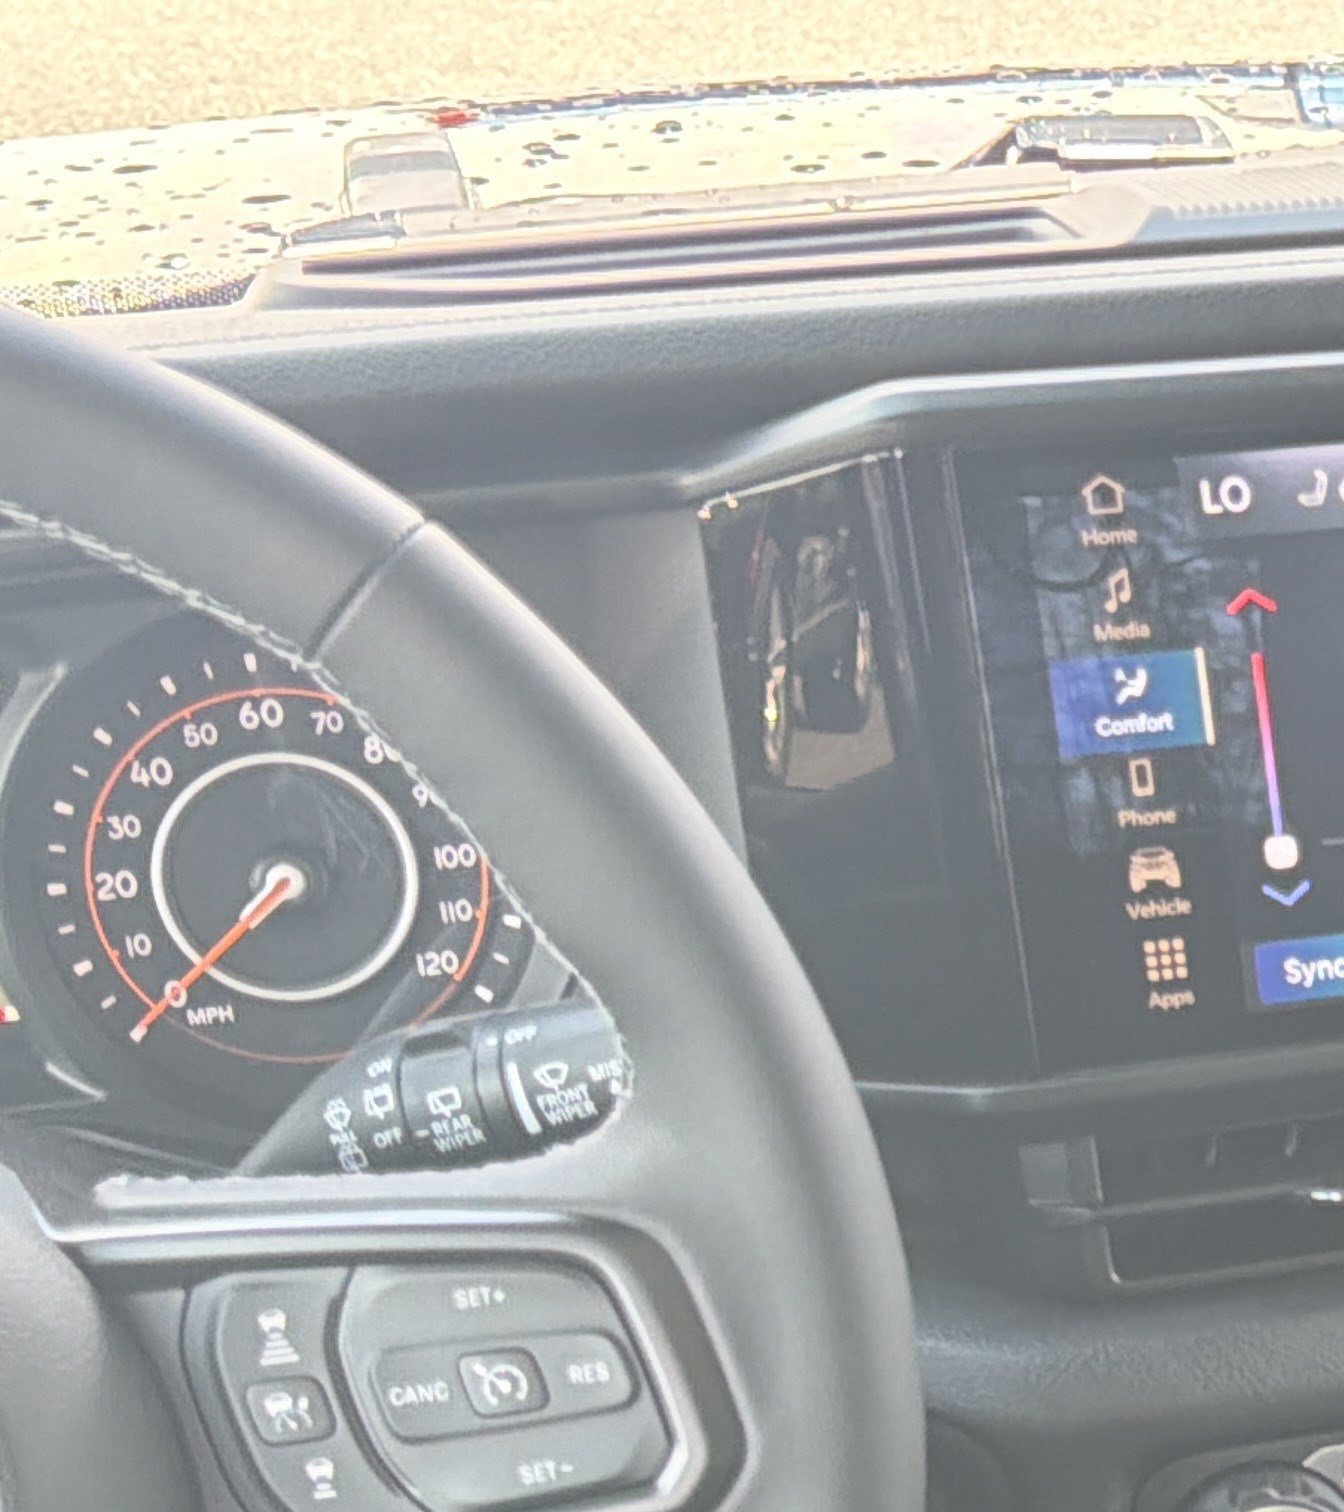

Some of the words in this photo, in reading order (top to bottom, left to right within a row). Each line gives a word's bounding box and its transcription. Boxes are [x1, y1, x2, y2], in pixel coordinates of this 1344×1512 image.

[1199, 475, 1252, 515] LO
[1081, 527, 1139, 547] Home
[1093, 620, 1151, 642] Media
[239, 698, 284, 731] 60
[310, 711, 344, 734] 70
[1094, 711, 1175, 737] Comfort
[182, 723, 218, 749] 50
[130, 757, 173, 787] 40
[107, 815, 142, 840] 30
[1117, 805, 1177, 829] Phone
[432, 844, 477, 870] 100
[96, 872, 138, 900] 20
[439, 899, 473, 924] 110
[1125, 896, 1193, 921] Vehicle
[125, 933, 153, 958] 10
[416, 952, 460, 978] 120
[1148, 987, 1196, 1012] Apps
[186, 1002, 236, 1026] MPH
[504, 1024, 539, 1046] OFF
[586, 1058, 624, 1082] MIS
[535, 1083, 590, 1116] FRONT
[430, 1113, 474, 1138] REAR
[547, 1099, 599, 1127] WIPER
[372, 1126, 402, 1149] OFF
[432, 1127, 488, 1154] WIPER
[566, 1362, 610, 1385] RES
[389, 1379, 450, 1407] CANC
